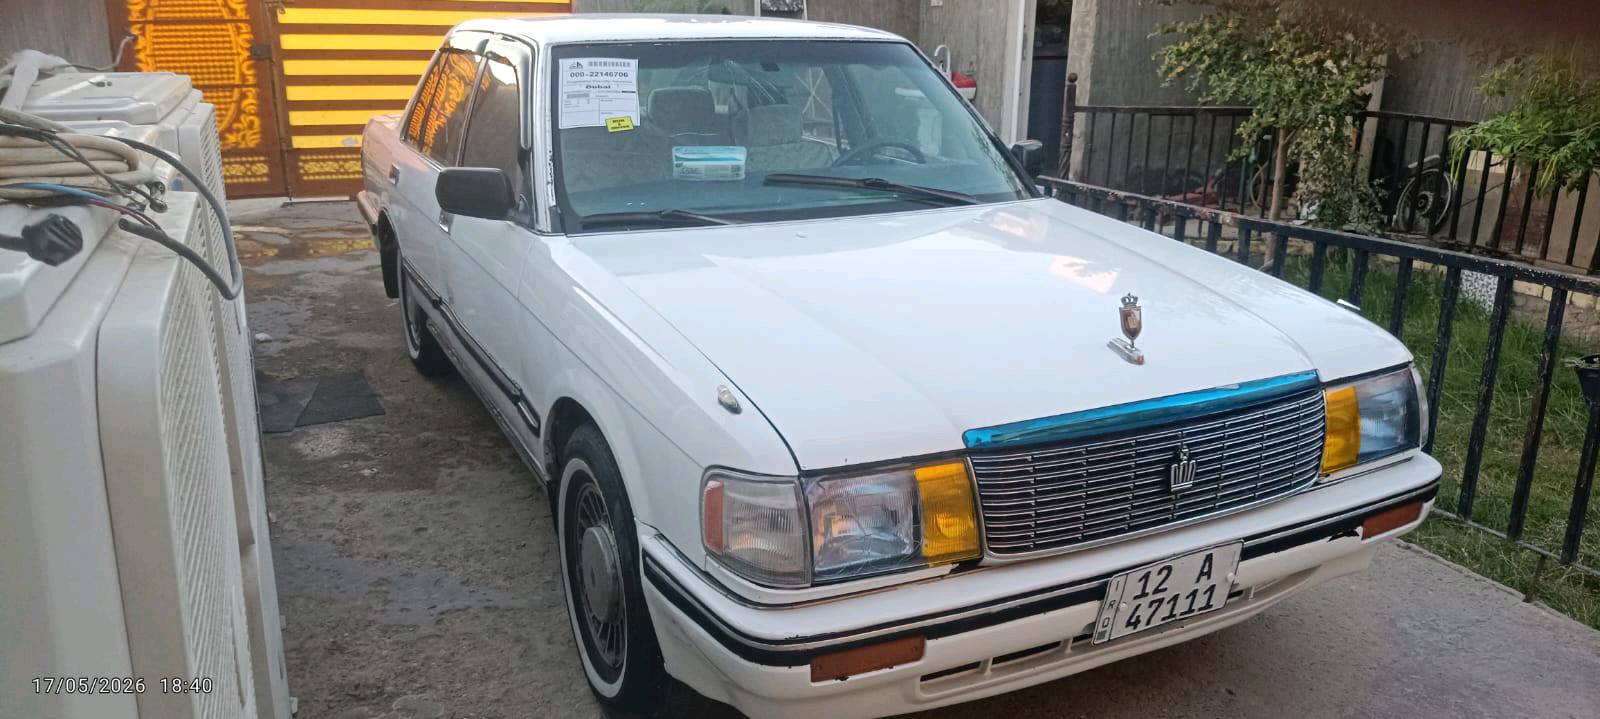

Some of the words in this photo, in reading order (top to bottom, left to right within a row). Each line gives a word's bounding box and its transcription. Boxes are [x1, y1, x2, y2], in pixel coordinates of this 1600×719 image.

[1133, 564, 1173, 600] 12
[1195, 552, 1214, 583] A
[1125, 583, 1217, 630] 47111
